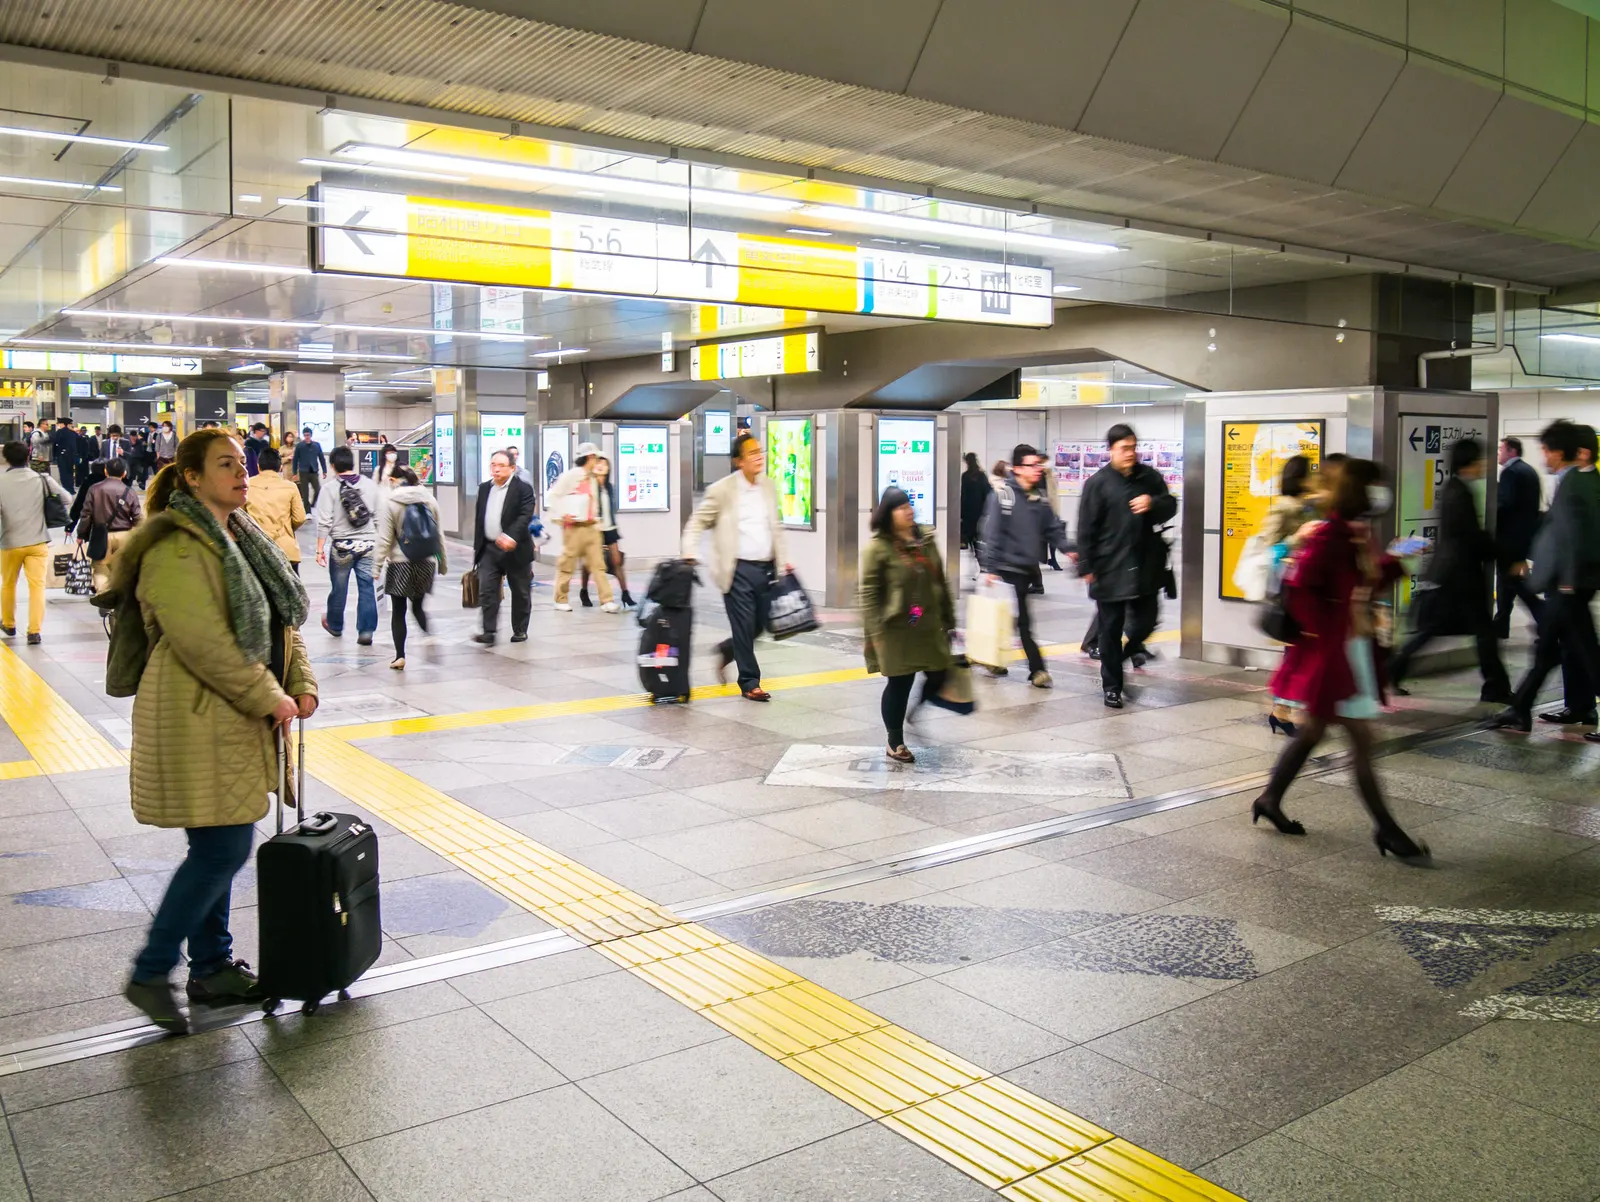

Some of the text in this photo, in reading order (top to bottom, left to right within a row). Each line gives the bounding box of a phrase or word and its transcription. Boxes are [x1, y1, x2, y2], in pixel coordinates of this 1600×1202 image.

[1013, 273, 1044, 290] 化粧室
[1442, 427, 1482, 440] エスカレーター
[364, 451, 373, 463] 4
